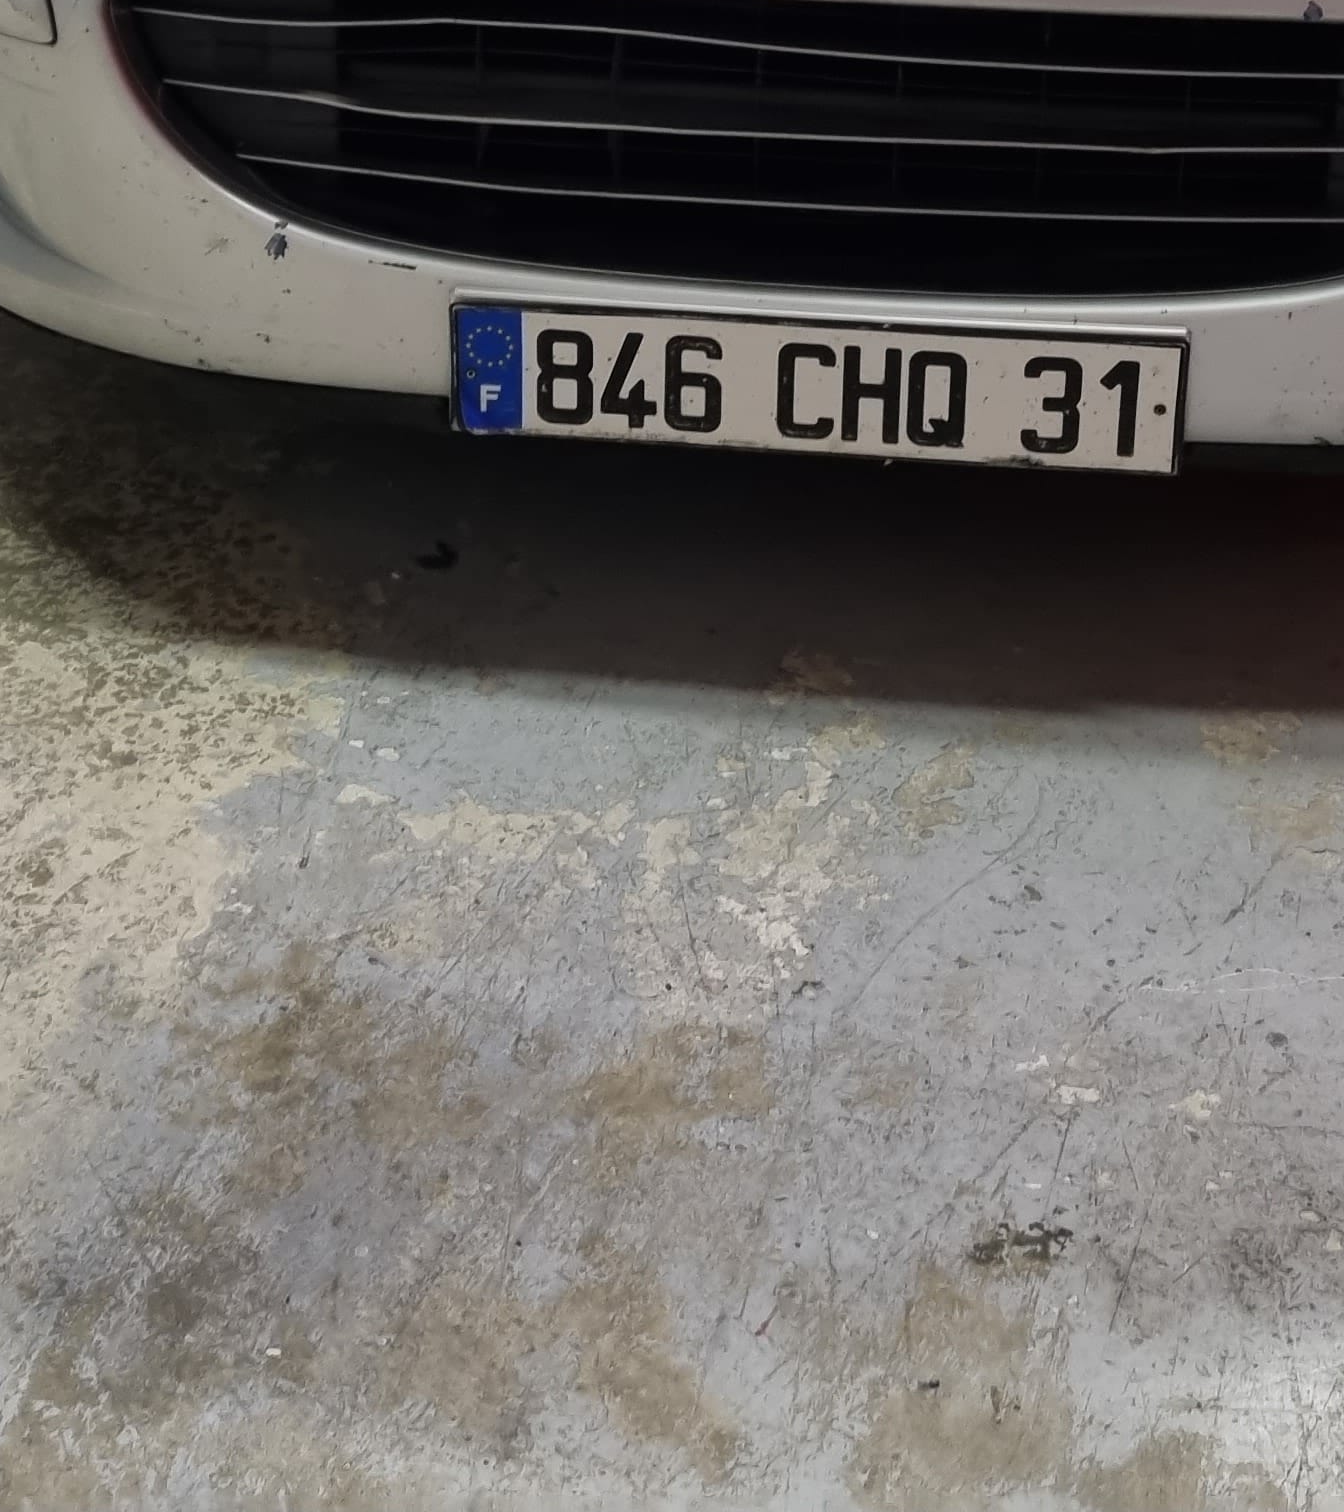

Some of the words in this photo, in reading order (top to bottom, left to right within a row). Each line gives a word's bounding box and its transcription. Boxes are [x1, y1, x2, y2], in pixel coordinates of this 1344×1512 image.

[479, 383, 502, 413] F
[535, 327, 723, 435] 846
[775, 341, 968, 448] CHQ
[1019, 355, 1141, 457] 31
